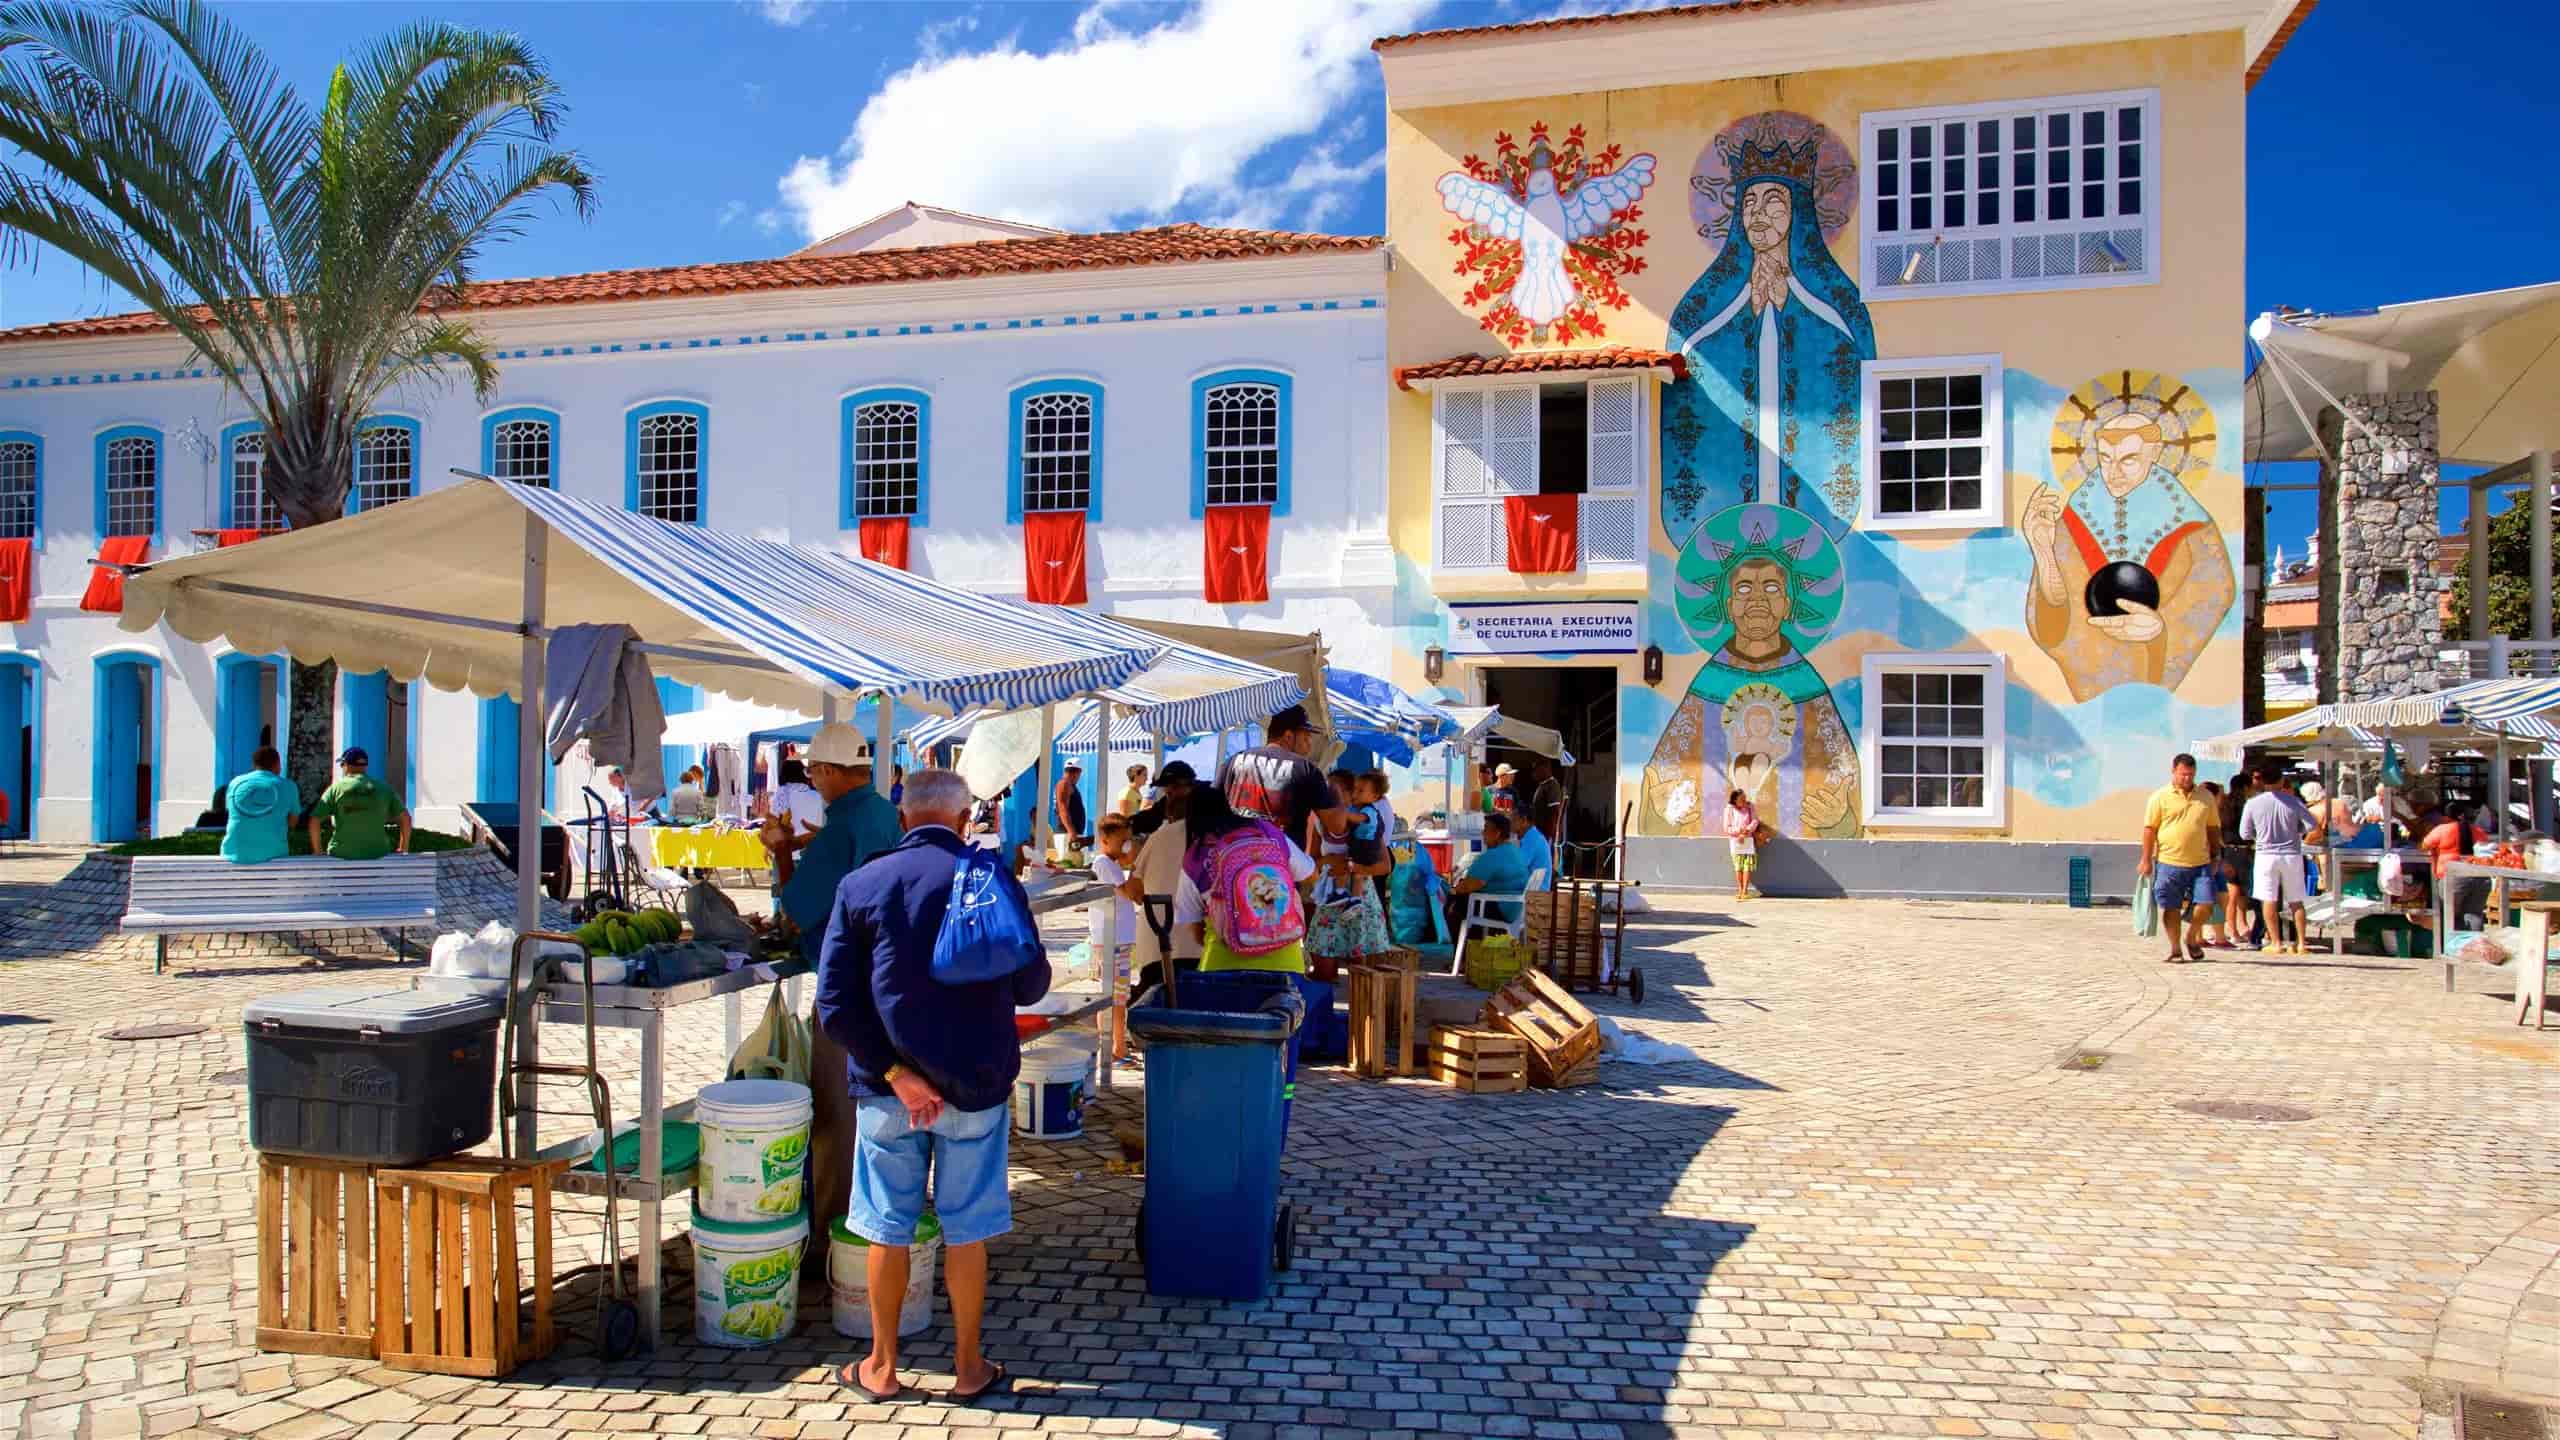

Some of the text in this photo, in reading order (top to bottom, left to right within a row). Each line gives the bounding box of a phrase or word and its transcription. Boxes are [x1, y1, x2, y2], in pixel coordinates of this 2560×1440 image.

[1477, 616, 1633, 626] SECRETARIA EXECUTIVA
[1477, 630, 1491, 639] DE
[1495, 629, 1548, 639] CULTURA
[1551, 629, 1560, 638] E
[1562, 627, 1633, 638] PATRIMÔNIO
[728, 1252, 788, 1288] FLOR
